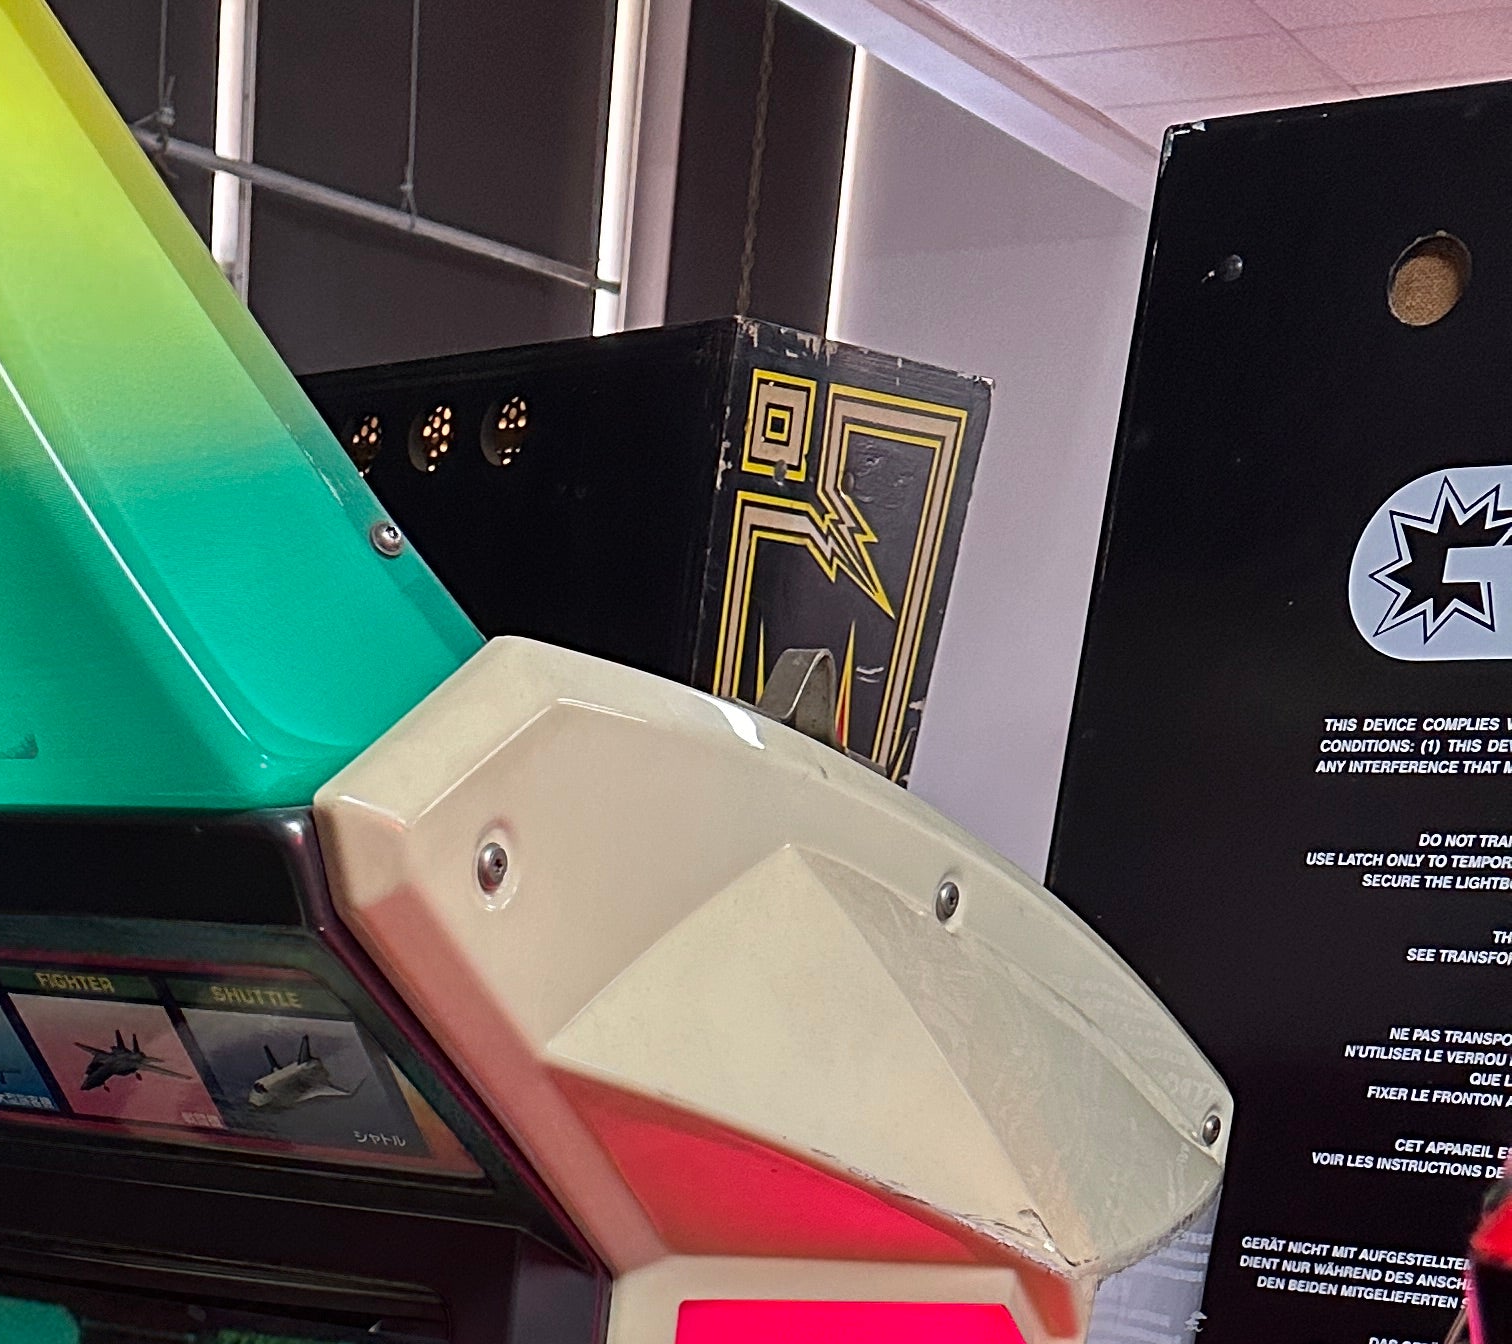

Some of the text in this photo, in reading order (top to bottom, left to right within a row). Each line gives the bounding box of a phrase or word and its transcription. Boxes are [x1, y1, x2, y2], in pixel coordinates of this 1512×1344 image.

[1324, 718, 1357, 732] THIS
[1363, 718, 1417, 732] DEVICE
[1423, 717, 1500, 731] COMPLIES
[1320, 739, 1415, 753] CONDITIONS:
[1420, 739, 1440, 755] (1)
[1448, 739, 1482, 753] THIS
[1315, 760, 1501, 773] ANY INTERFERENCE THAT
[1419, 834, 1441, 847] DO
[1445, 834, 1476, 847] NOT
[1306, 852, 1335, 866] USE
[1338, 853, 1383, 866] LATCH
[1386, 854, 1425, 867] ONLY
[1428, 855, 1447, 867] TO
[1362, 874, 1421, 888] SECURE
[1424, 875, 1453, 888] THE
[1406, 948, 1436, 962] SEE
[35, 972, 115, 993] FIGHTER
[211, 985, 303, 1009] SHUTTLE
[1389, 1027, 1410, 1041] NE
[1413, 1029, 1440, 1043] PAS
[1345, 1045, 1421, 1061] N'UTILISER
[1424, 1050, 1443, 1062] LE
[1447, 1051, 1507, 1066] VERROU
[1469, 1072, 1501, 1087] QUE
[1367, 1086, 1502, 1107] FIXER LE FRONTON
[352, 1130, 406, 1148] シャトル
[1395, 1139, 1423, 1153] CET
[1425, 1141, 1494, 1159] APPAREIL
[1311, 1152, 1505, 1179] VOIR LES INSTRUCTIONS DE
[1242, 1236, 1286, 1252] GERÄT
[1288, 1242, 1330, 1258] NICHT
[1332, 1246, 1357, 1259] MIT
[1240, 1255, 1279, 1270] DIENT
[1281, 1260, 1310, 1273] NUR
[1314, 1261, 1382, 1281] WÄHREND
[1385, 1271, 1414, 1285] DES
[1257, 1276, 1458, 1309] DEN BEIDEN MITGELIEFERTEN
